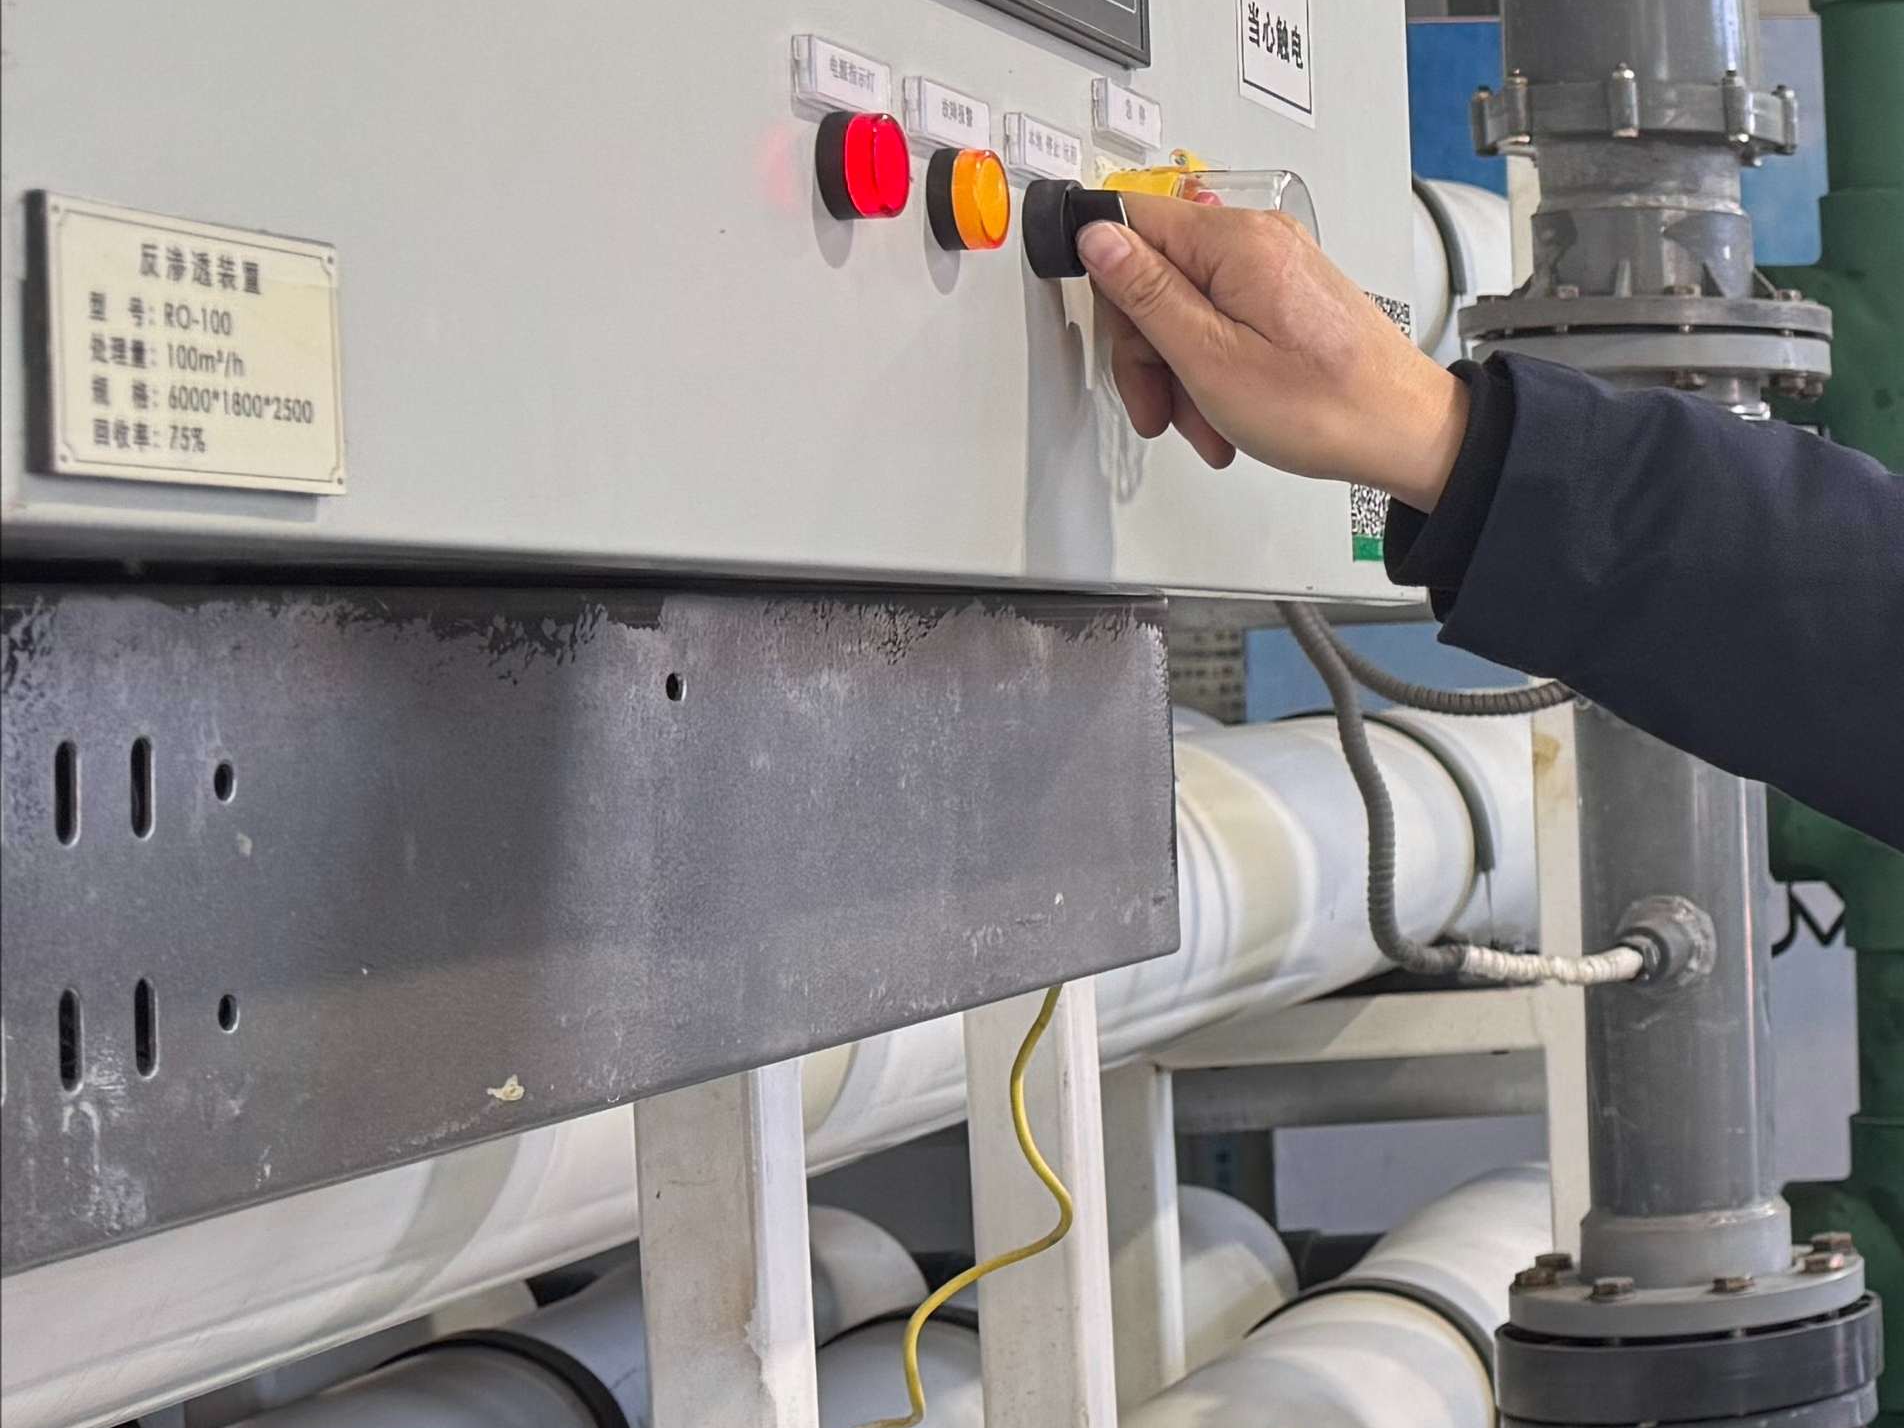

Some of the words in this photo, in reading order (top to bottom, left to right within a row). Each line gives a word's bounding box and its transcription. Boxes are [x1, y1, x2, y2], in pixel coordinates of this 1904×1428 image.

[1247, 3, 1304, 70] 当心触电
[138, 243, 262, 295] 反渗透装置
[163, 302, 233, 337] RO-100
[168, 425, 207, 455] 75%
